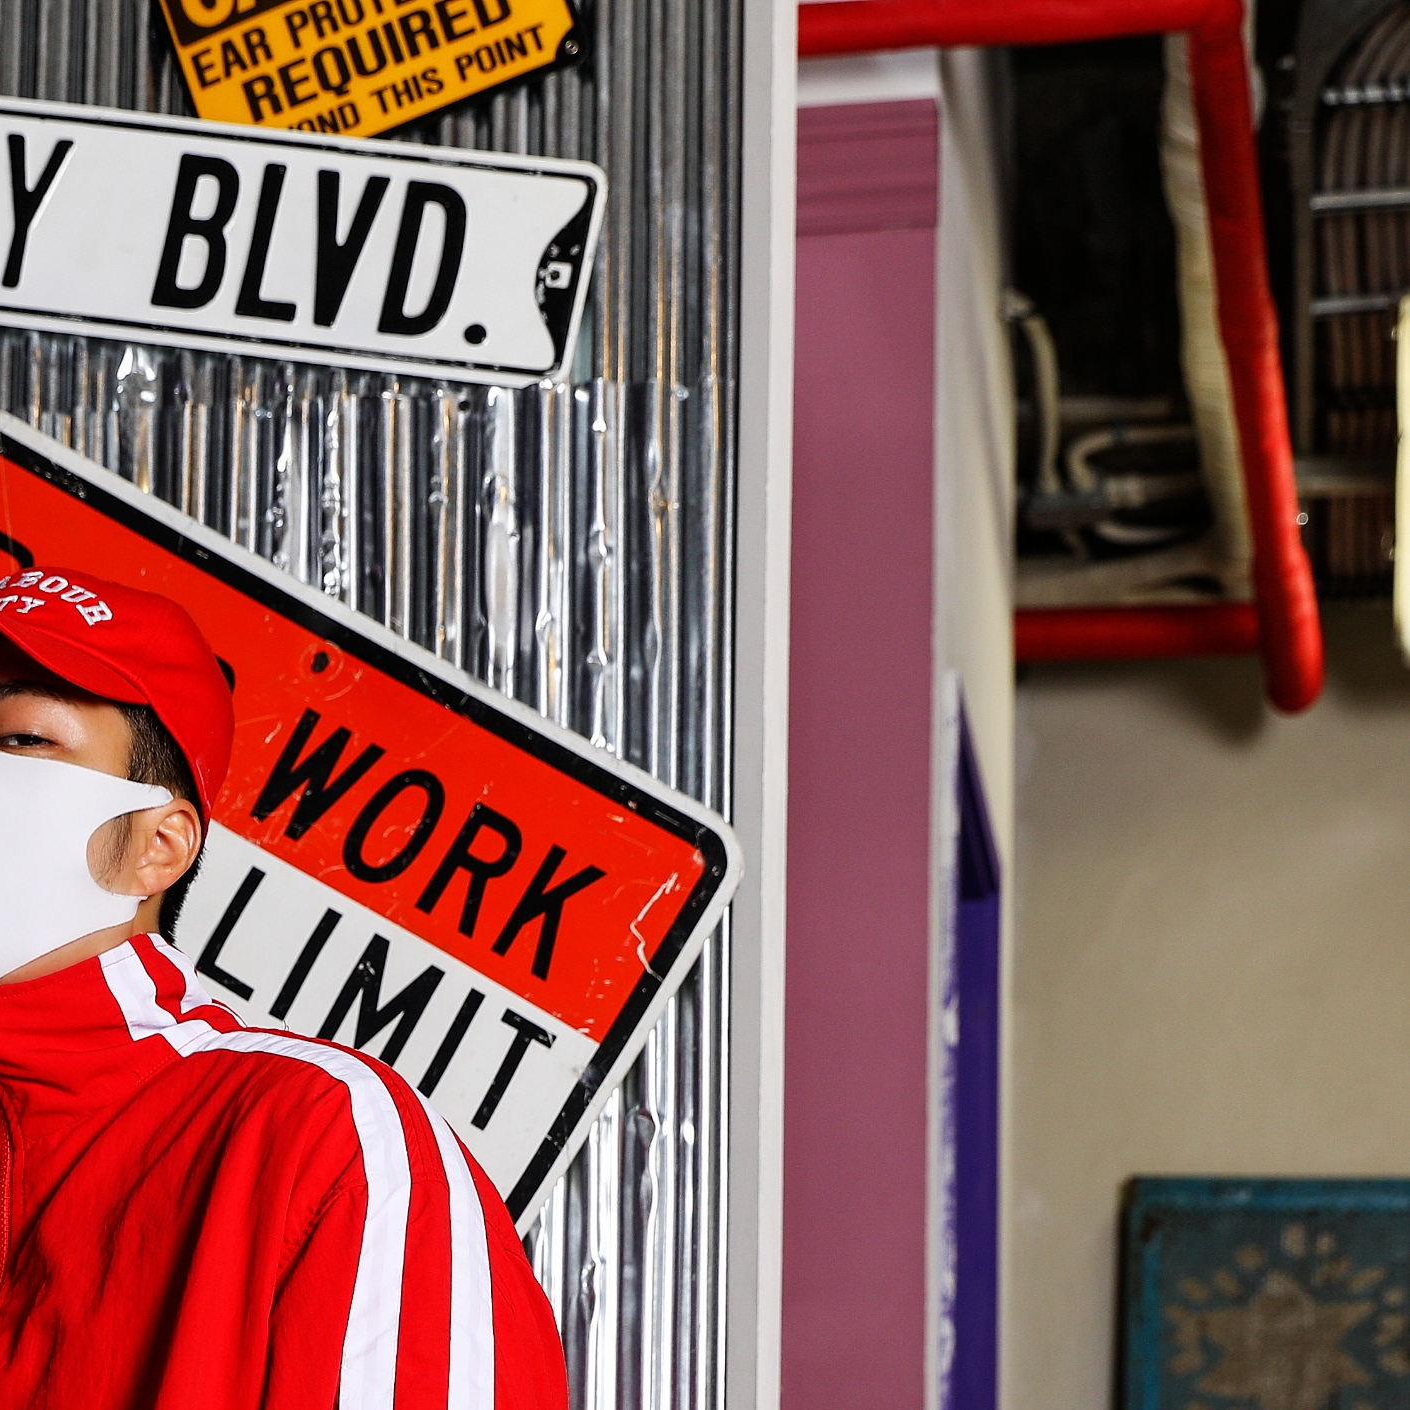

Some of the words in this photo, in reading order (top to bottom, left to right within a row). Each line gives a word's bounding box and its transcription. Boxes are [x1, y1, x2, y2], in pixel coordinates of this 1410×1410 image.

[191, 27, 273, 90] EAR
[242, 0, 512, 123] REQUIRED
[369, 67, 445, 115] THIS
[454, 22, 546, 83] POINT
[150, 153, 487, 345] BLVD.
[250, 707, 606, 981] WORK
[196, 866, 557, 1132] LIMIT
